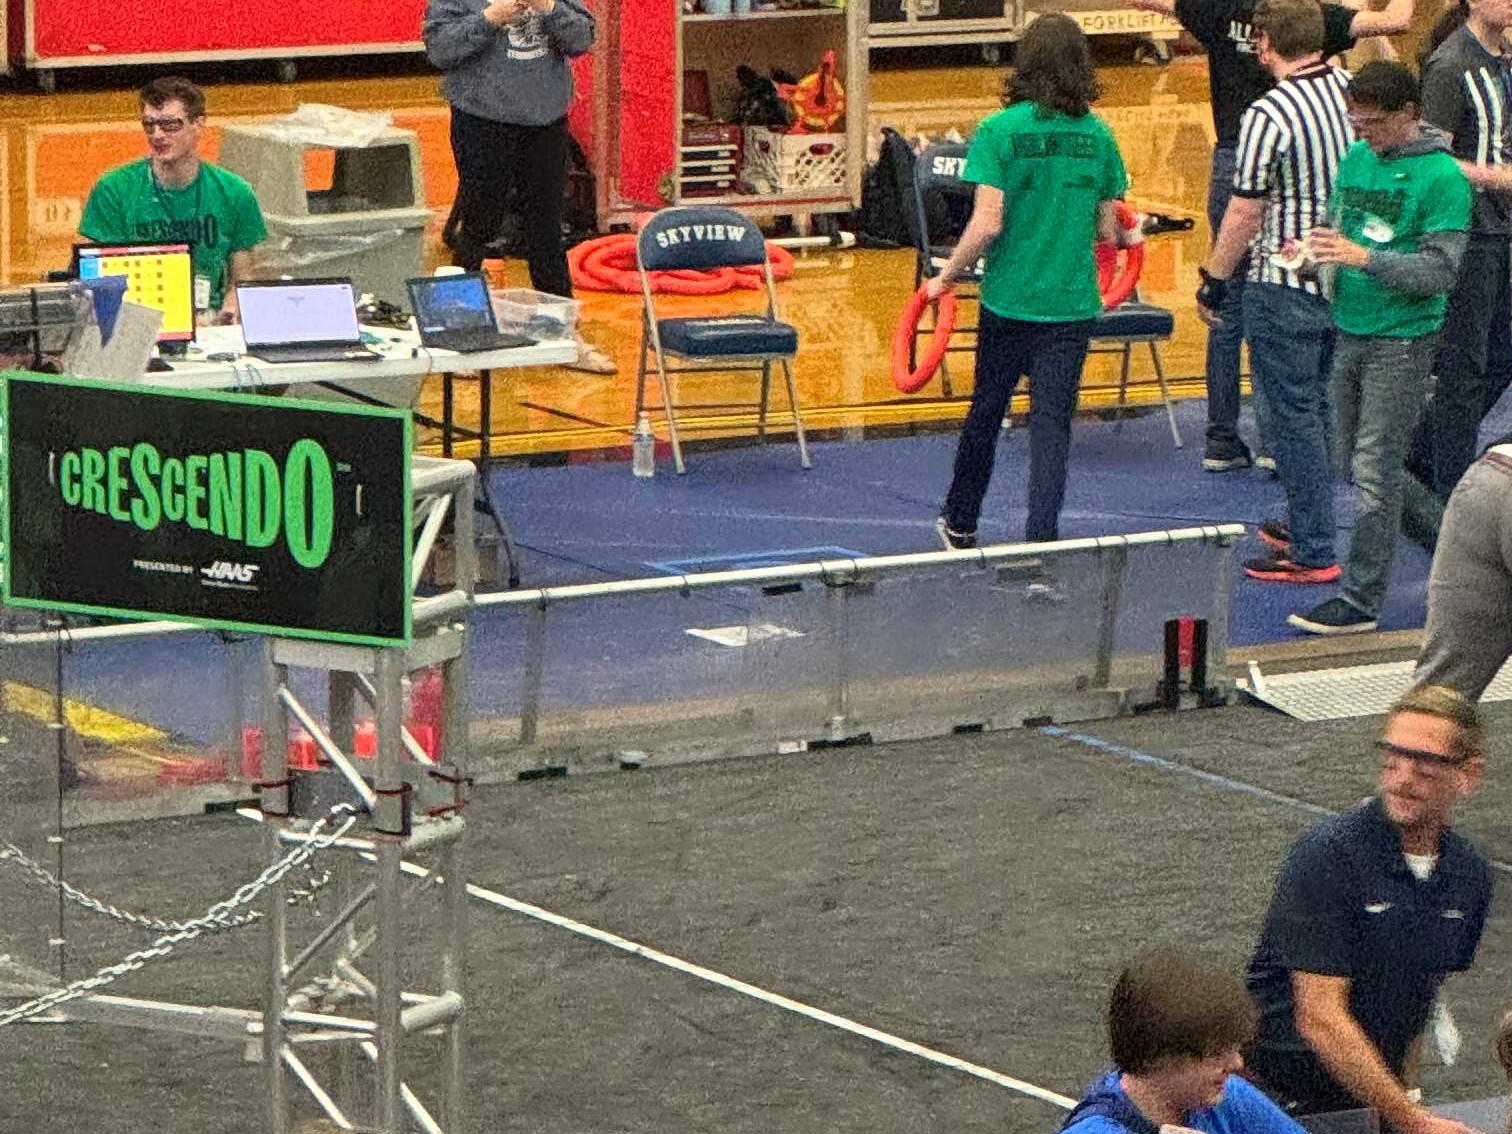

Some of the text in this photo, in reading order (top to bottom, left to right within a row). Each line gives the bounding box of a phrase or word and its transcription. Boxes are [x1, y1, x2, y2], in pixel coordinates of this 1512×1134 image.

[1083, 13, 1155, 30] FORKLIFT
[655, 224, 747, 249] SKYVIEW
[60, 438, 334, 568] CRESCENDO
